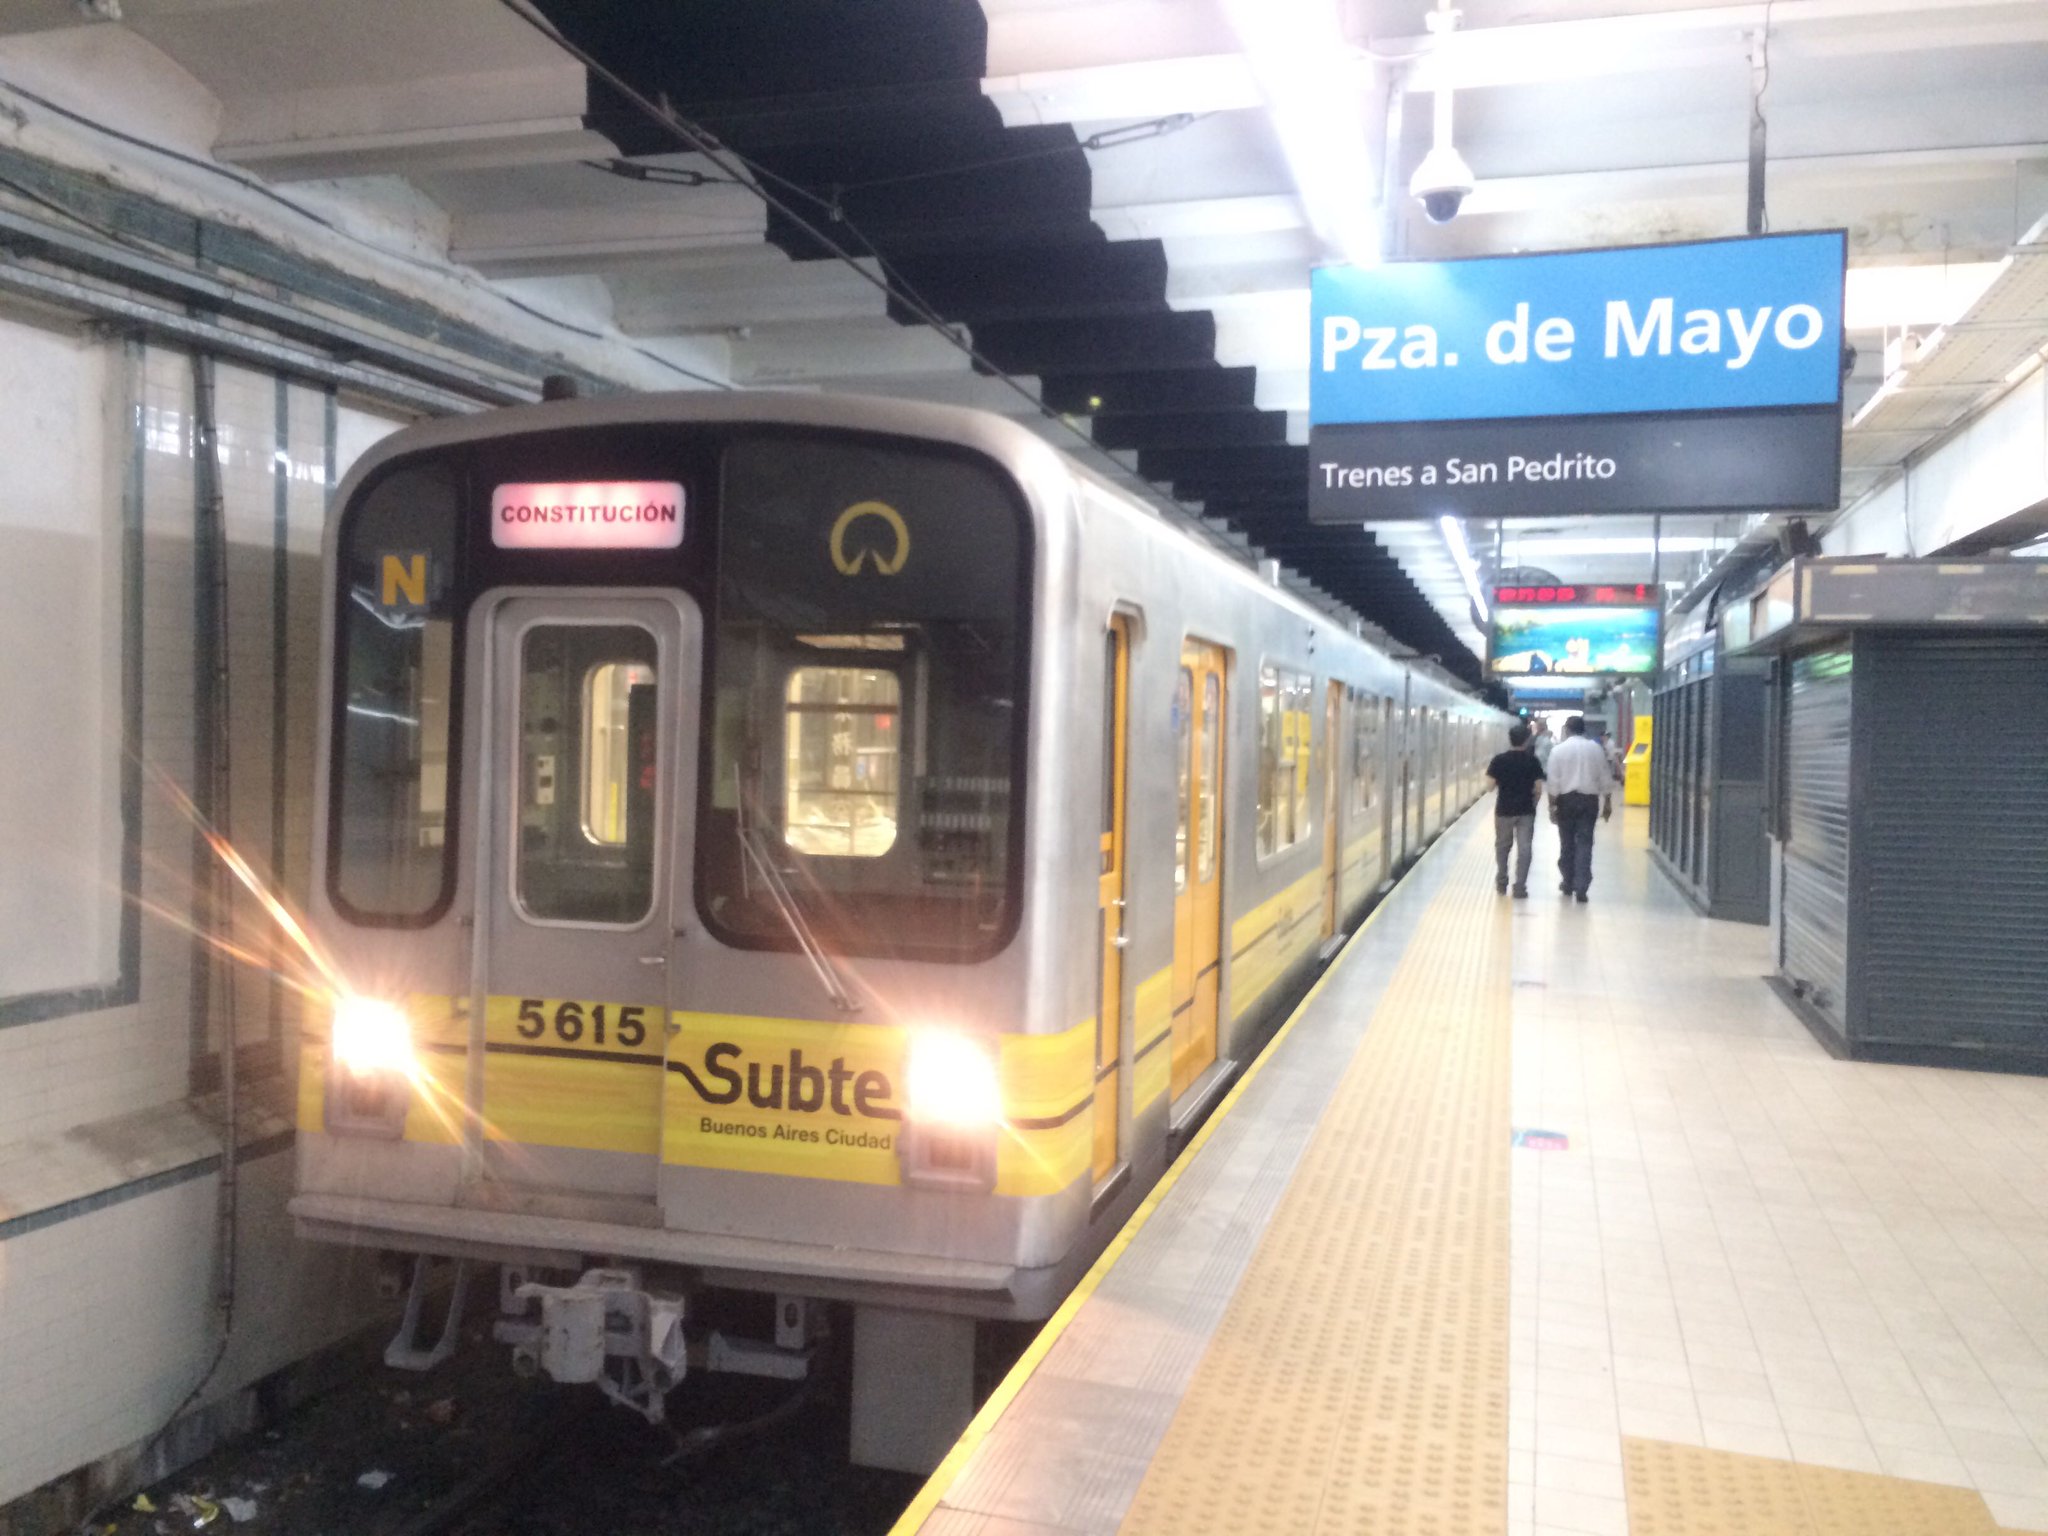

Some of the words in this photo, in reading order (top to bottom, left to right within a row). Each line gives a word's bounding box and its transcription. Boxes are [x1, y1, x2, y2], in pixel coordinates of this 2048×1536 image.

[1321, 314, 1459, 373] Pza.
[1485, 302, 1576, 364] de
[1603, 297, 1825, 369] Mayo
[1319, 462, 1413, 489] Trenes
[1420, 463, 1438, 486] a
[1445, 457, 1498, 485] San
[1506, 452, 1617, 482] Pedrito
[500, 501, 677, 523] CONSTITUCIÓN
[382, 553, 426, 606] N
[516, 999, 647, 1047] 5615
[702, 1042, 900, 1120] Subte
[699, 1116, 768, 1139] Buenos
[773, 1123, 820, 1143] Aires
[825, 1127, 892, 1151] Ciudad
